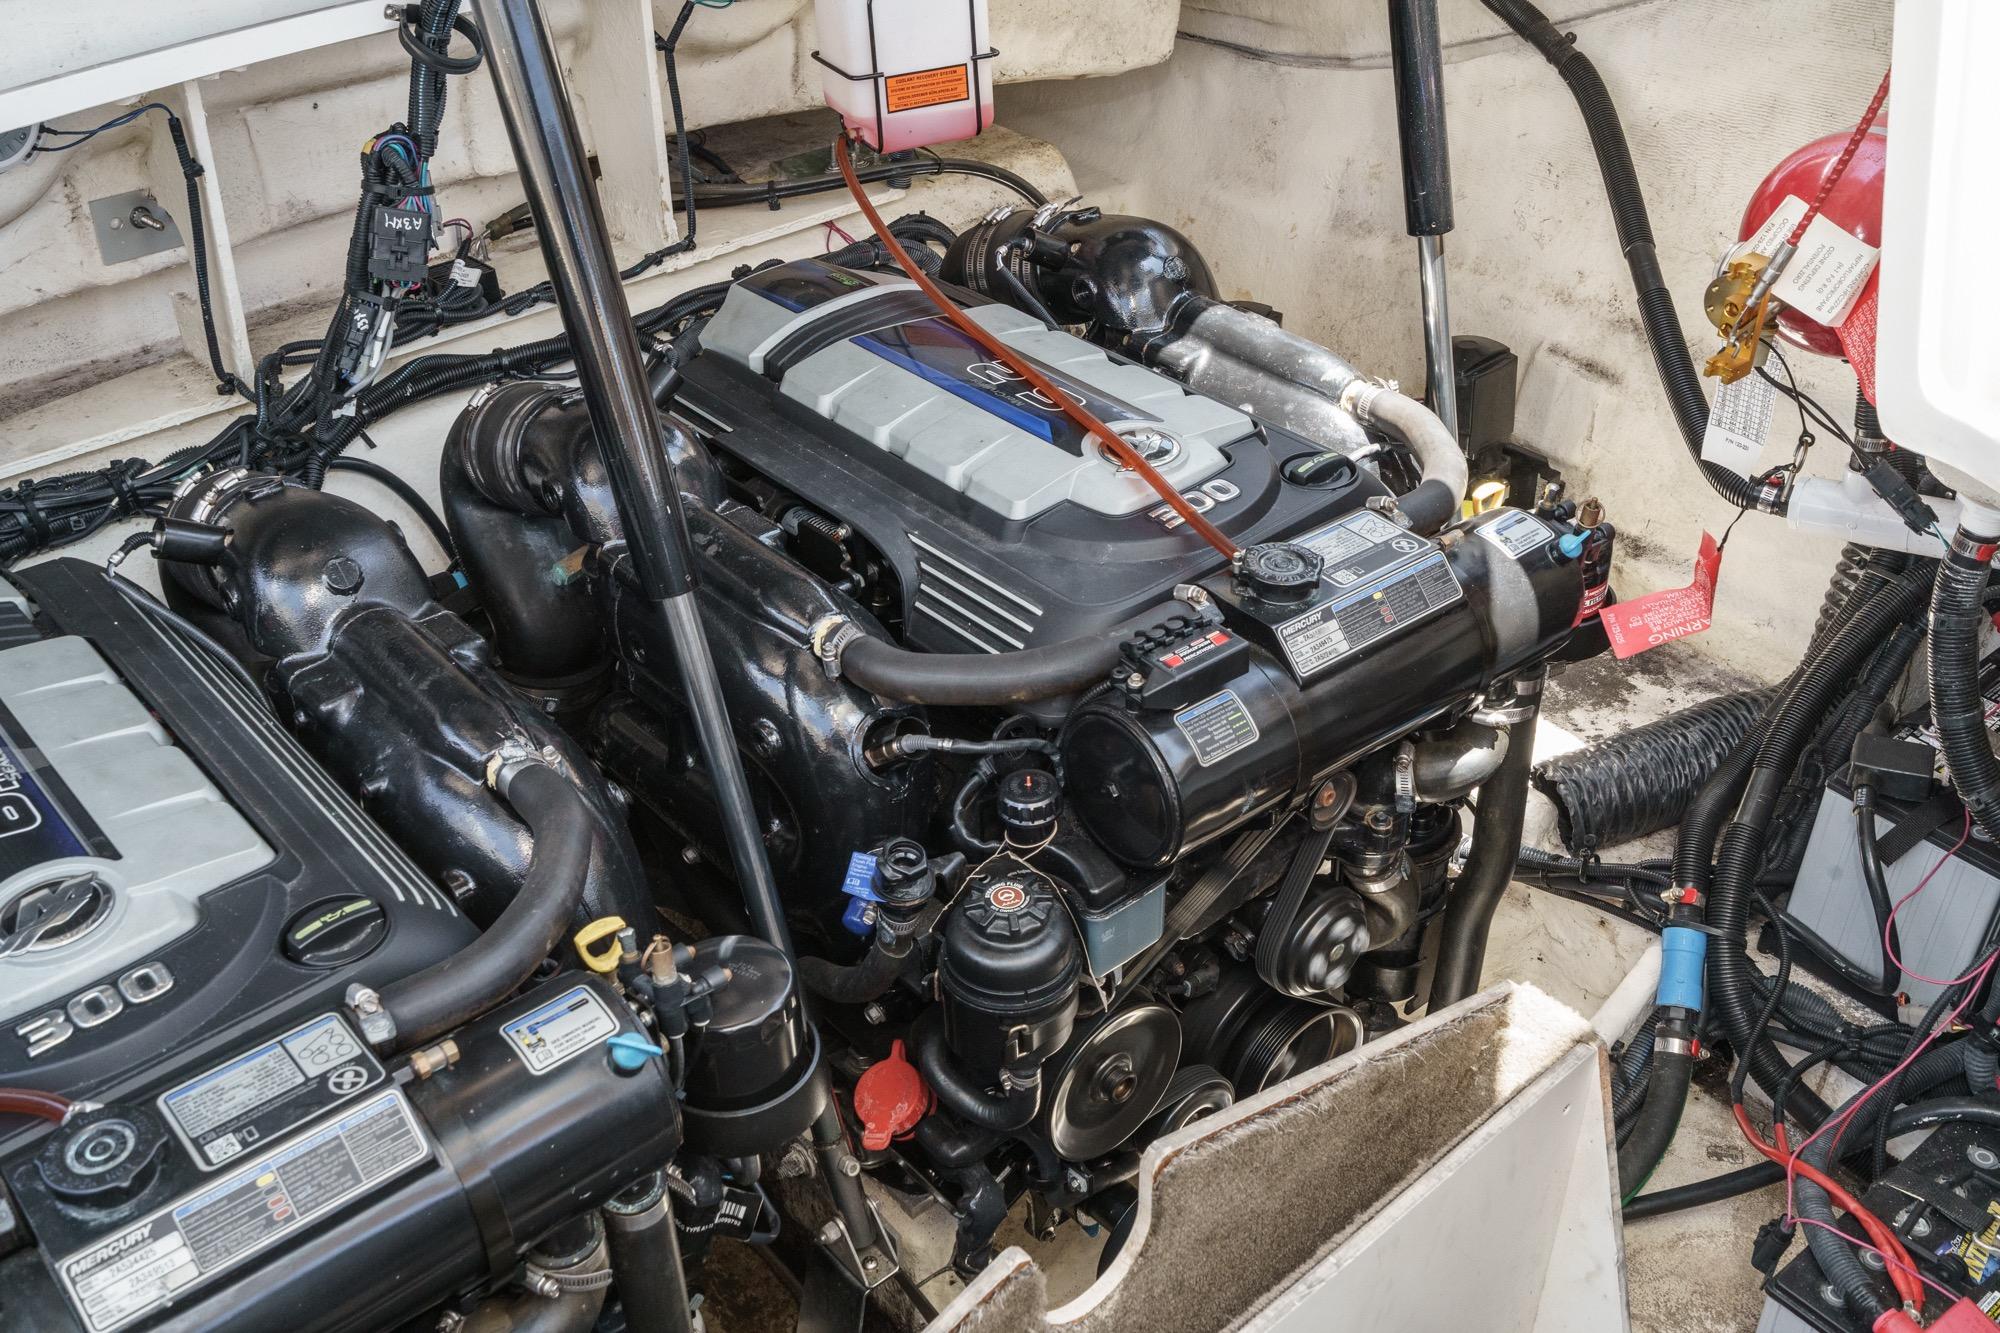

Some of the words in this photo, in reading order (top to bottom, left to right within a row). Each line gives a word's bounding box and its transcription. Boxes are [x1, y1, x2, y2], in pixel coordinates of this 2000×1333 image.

[895, 76, 915, 84] COOLANT
[916, 72, 938, 80] RECOVERY
[1801, 243, 1825, 271] POTENTIAL
[1817, 246, 1835, 266] OZONE
[1791, 268, 1805, 284] ZERO
[1797, 263, 1821, 292] DEPLETING
[1282, 611, 1321, 637] MERCURY
[1647, 616, 1710, 645] ARNING
[984, 881, 1006, 898] STEERING
[14, 960, 175, 1057] 300
[71, 1222, 151, 1278] MERCURY
